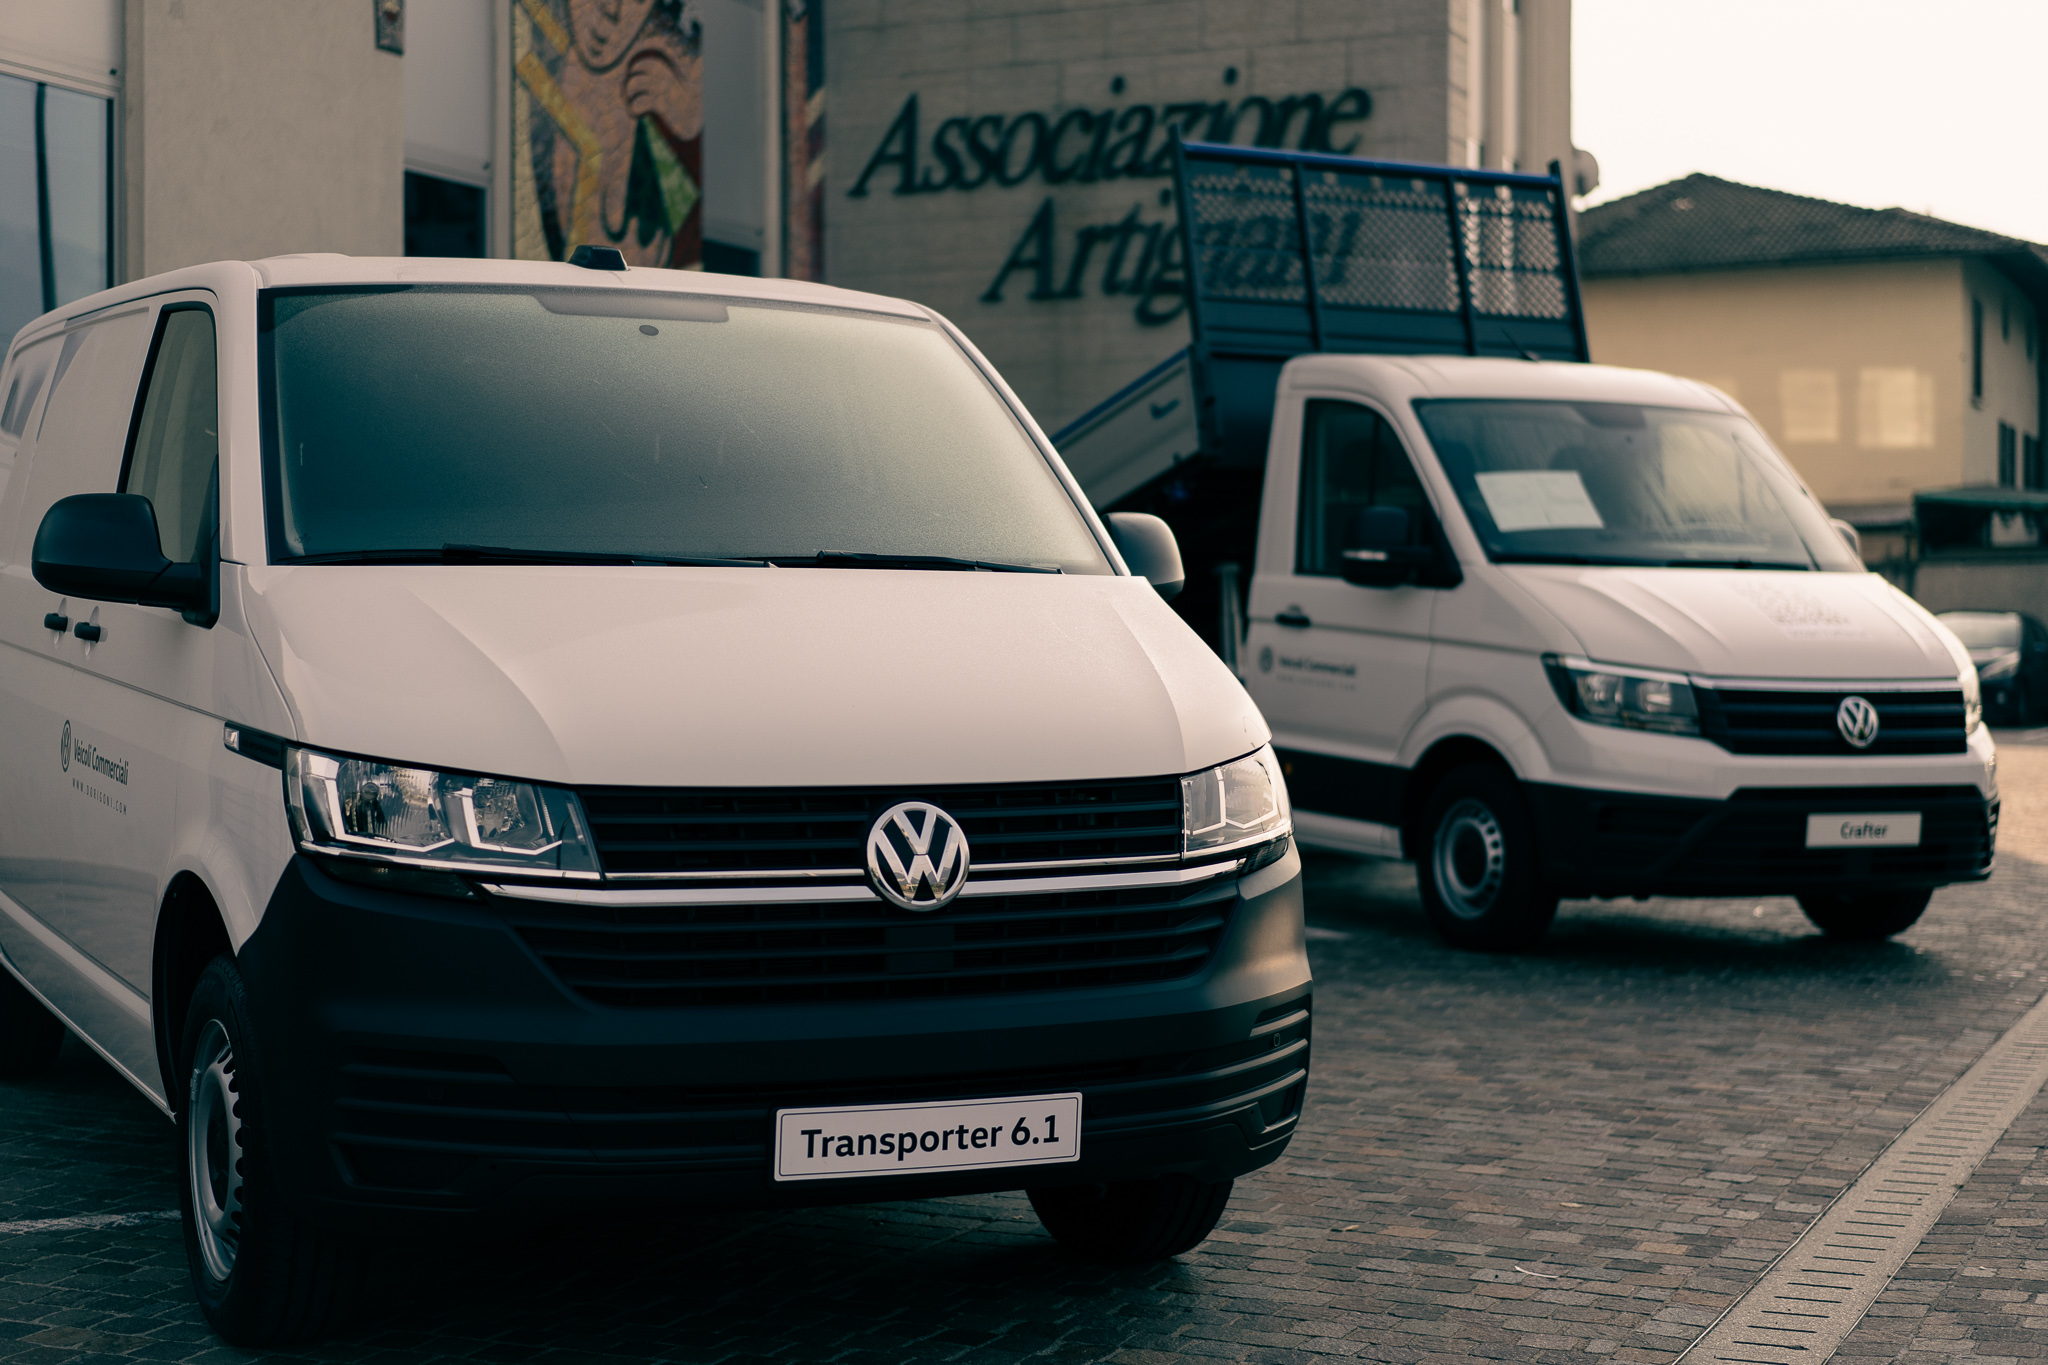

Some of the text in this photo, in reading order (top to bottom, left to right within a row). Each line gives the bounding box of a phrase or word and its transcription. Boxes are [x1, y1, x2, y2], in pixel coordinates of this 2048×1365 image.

[847, 66, 1374, 199] Associazione
[74, 738, 129, 786] Veicoli Commerciali
[1840, 821, 1888, 839] Crafter
[801, 1114, 1060, 1162] Transporter 6.1
